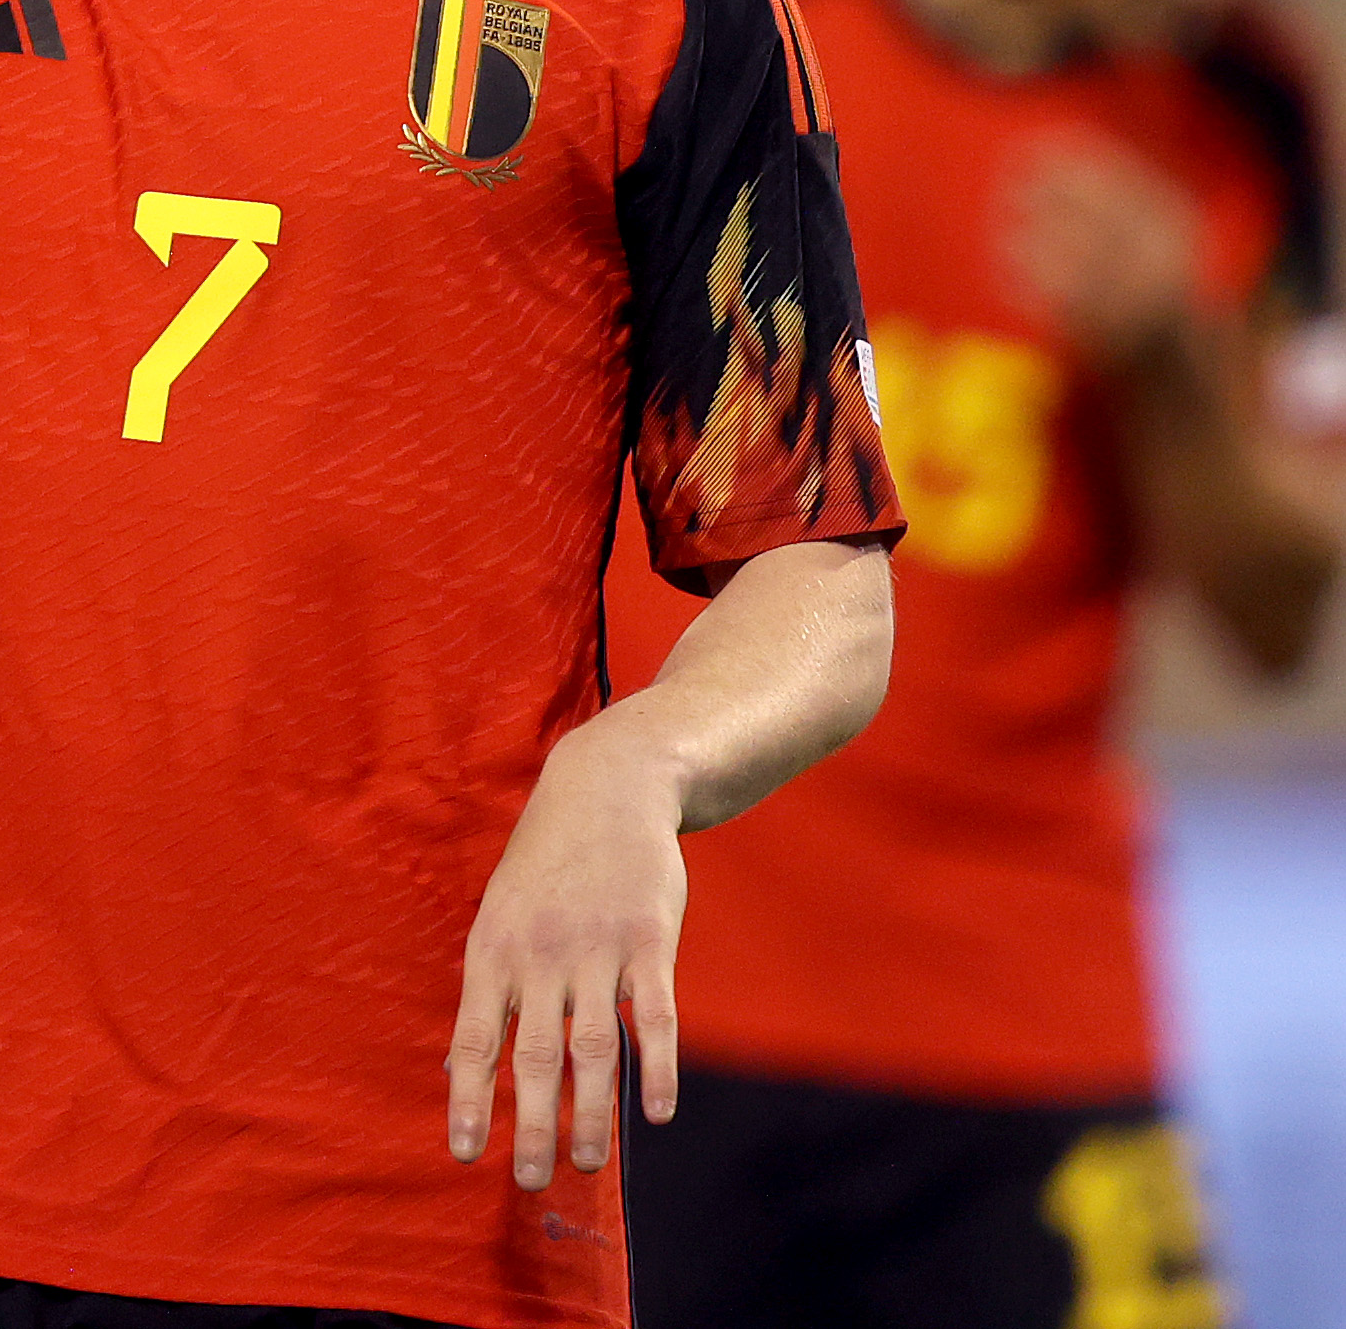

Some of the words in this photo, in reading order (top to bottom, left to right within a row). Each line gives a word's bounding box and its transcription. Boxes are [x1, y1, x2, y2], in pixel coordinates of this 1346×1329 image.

[486, 2, 530, 22] ROYAL
[484, 15, 544, 40] BELGIAN
[121, 191, 282, 443] 7
